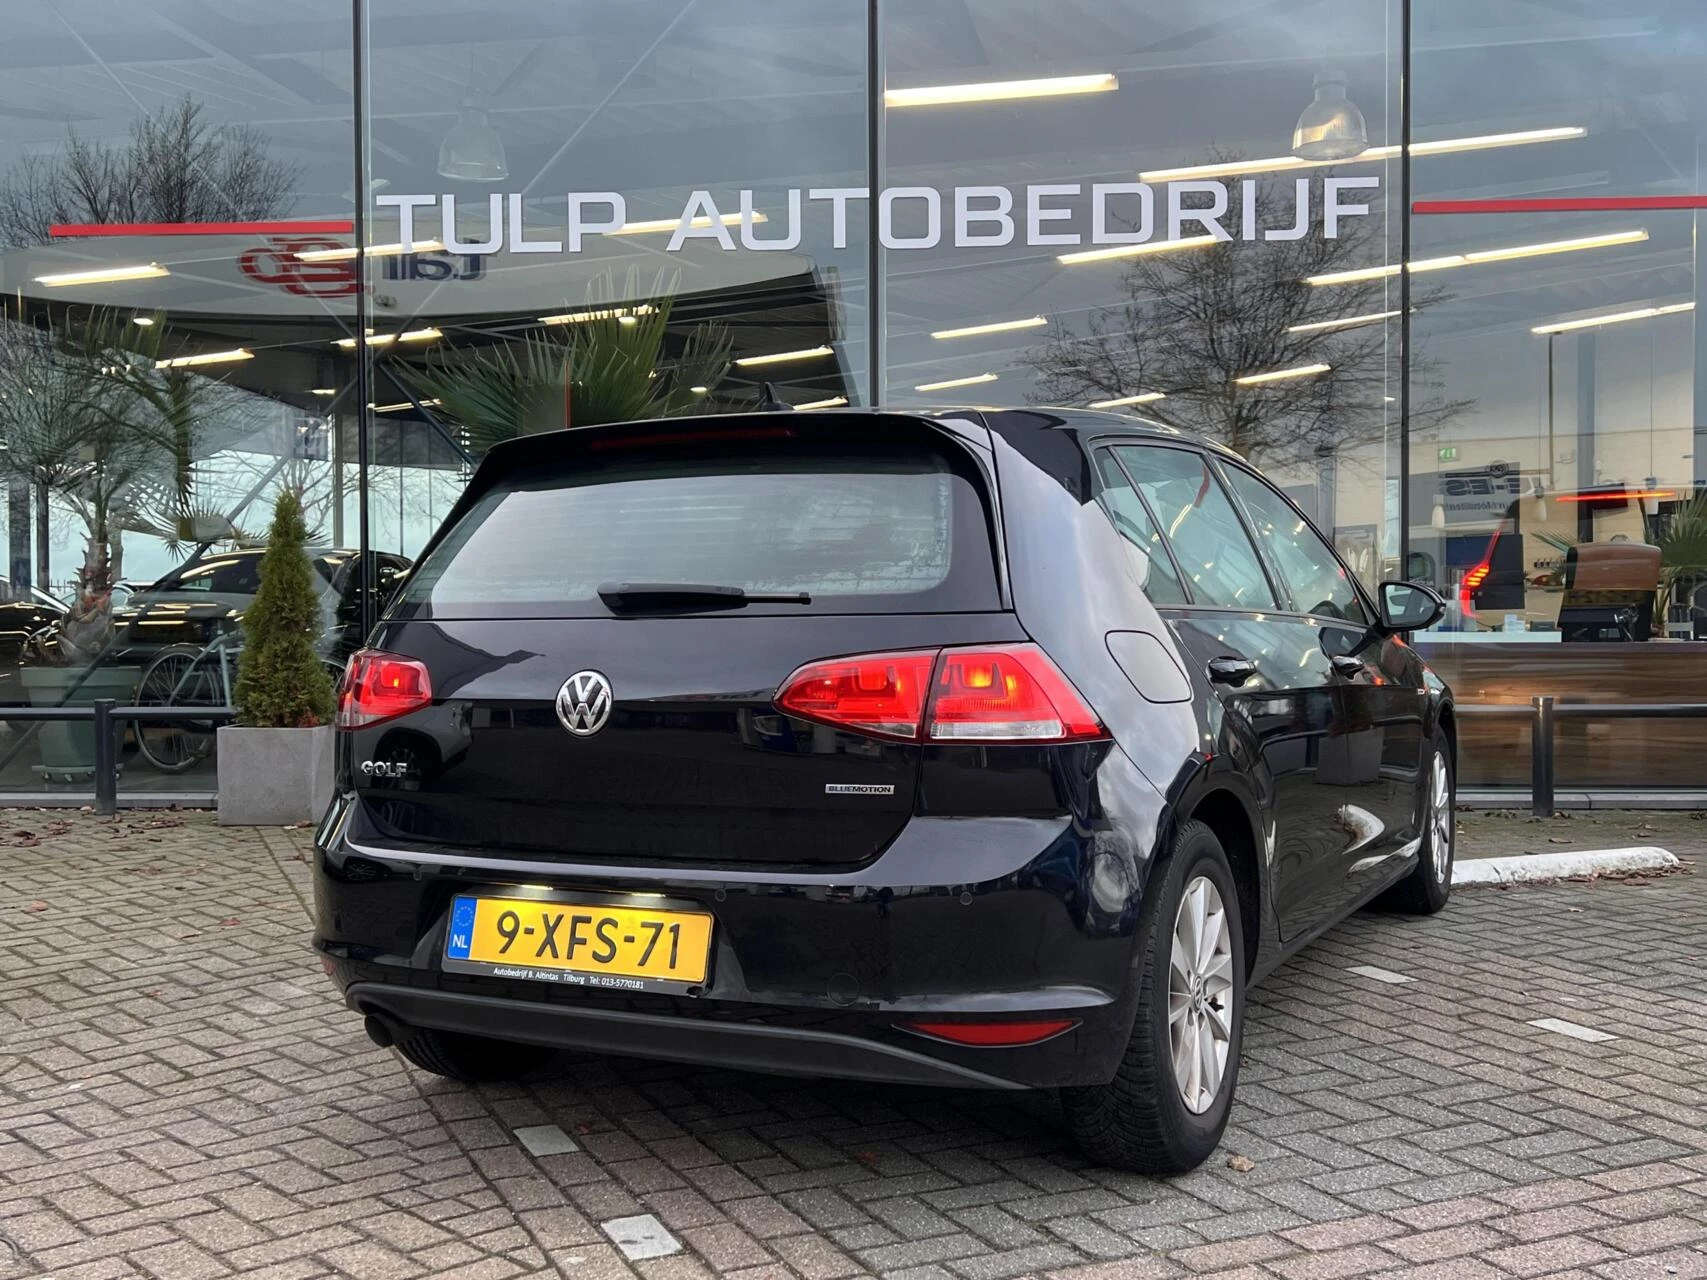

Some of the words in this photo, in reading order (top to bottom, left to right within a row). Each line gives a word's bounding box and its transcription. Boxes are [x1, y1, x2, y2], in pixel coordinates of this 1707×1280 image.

[376, 191, 626, 256] TULP
[665, 176, 1379, 252] AUTOBEDRIJF
[360, 760, 408, 778] GOLF
[827, 785, 892, 793] BLUEMOTION
[452, 934, 469, 949] NL
[496, 909, 681, 970] 9-XFS-71
[493, 967, 528, 980] Autobedrijf
[535, 972, 559, 981] Altintas
[563, 973, 585, 985] Tilburg
[589, 976, 601, 985] Tel:
[601, 977, 645, 990] 013-5770181
